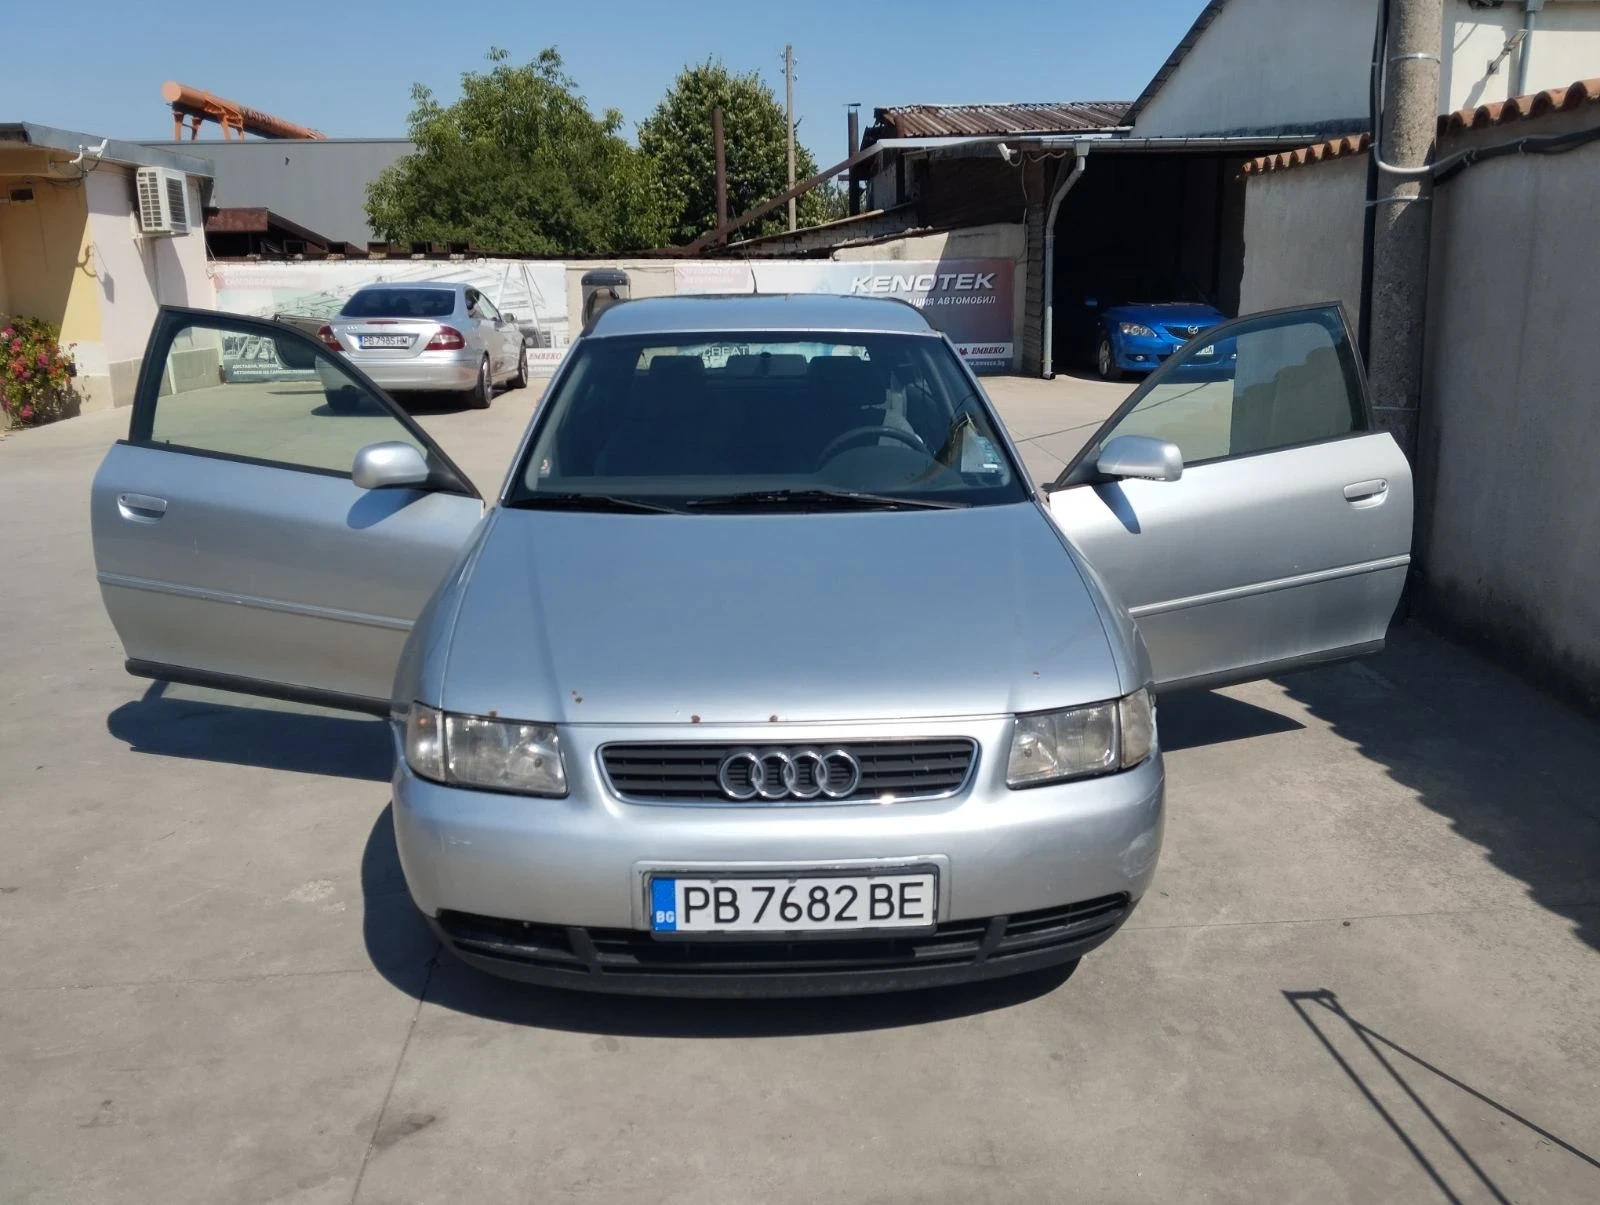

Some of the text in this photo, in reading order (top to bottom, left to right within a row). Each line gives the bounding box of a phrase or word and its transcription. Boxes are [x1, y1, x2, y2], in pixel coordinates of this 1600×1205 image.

[851, 273, 996, 293] KENOTEK
[937, 296, 996, 305] АВТОМОБИЛ
[684, 881, 924, 924] PB 7682 BE
[656, 910, 674, 923] BG
